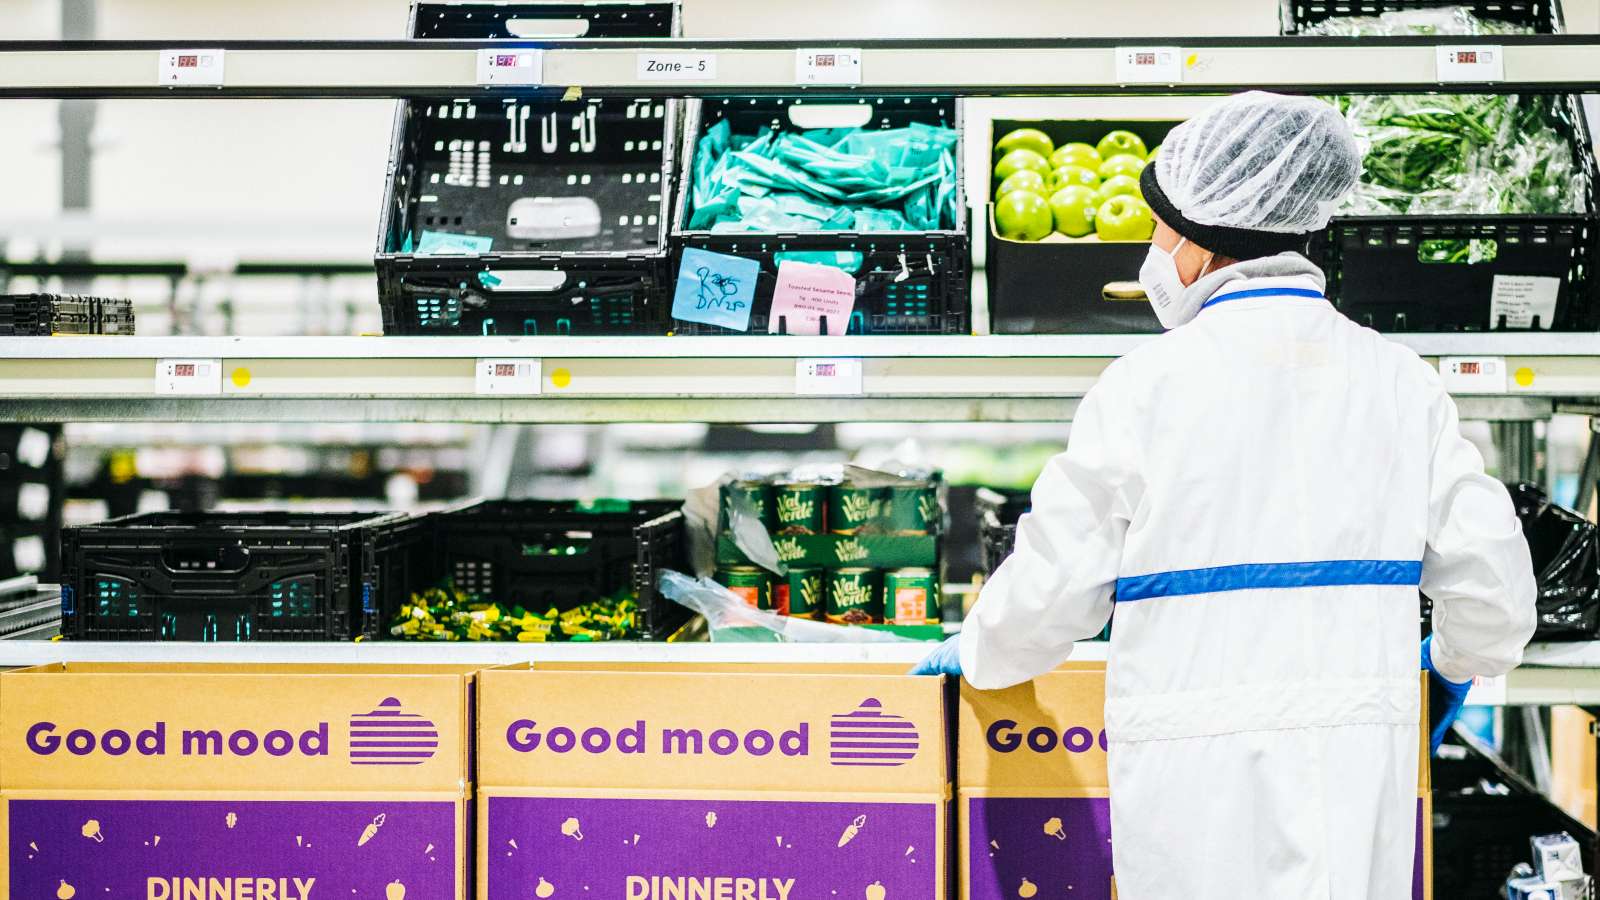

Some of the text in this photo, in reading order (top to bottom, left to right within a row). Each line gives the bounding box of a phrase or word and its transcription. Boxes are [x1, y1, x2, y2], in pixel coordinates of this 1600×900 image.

[646, 60, 682, 72] Zone
[698, 60, 706, 72] 5
[777, 491, 801, 514] Val
[835, 537, 858, 555] Val
[833, 575, 861, 596] Val
[26, 721, 329, 756] Good mood
[506, 719, 809, 756] Good mood
[146, 876, 316, 900] DINNERLY
[625, 875, 796, 900] DINNERLY
